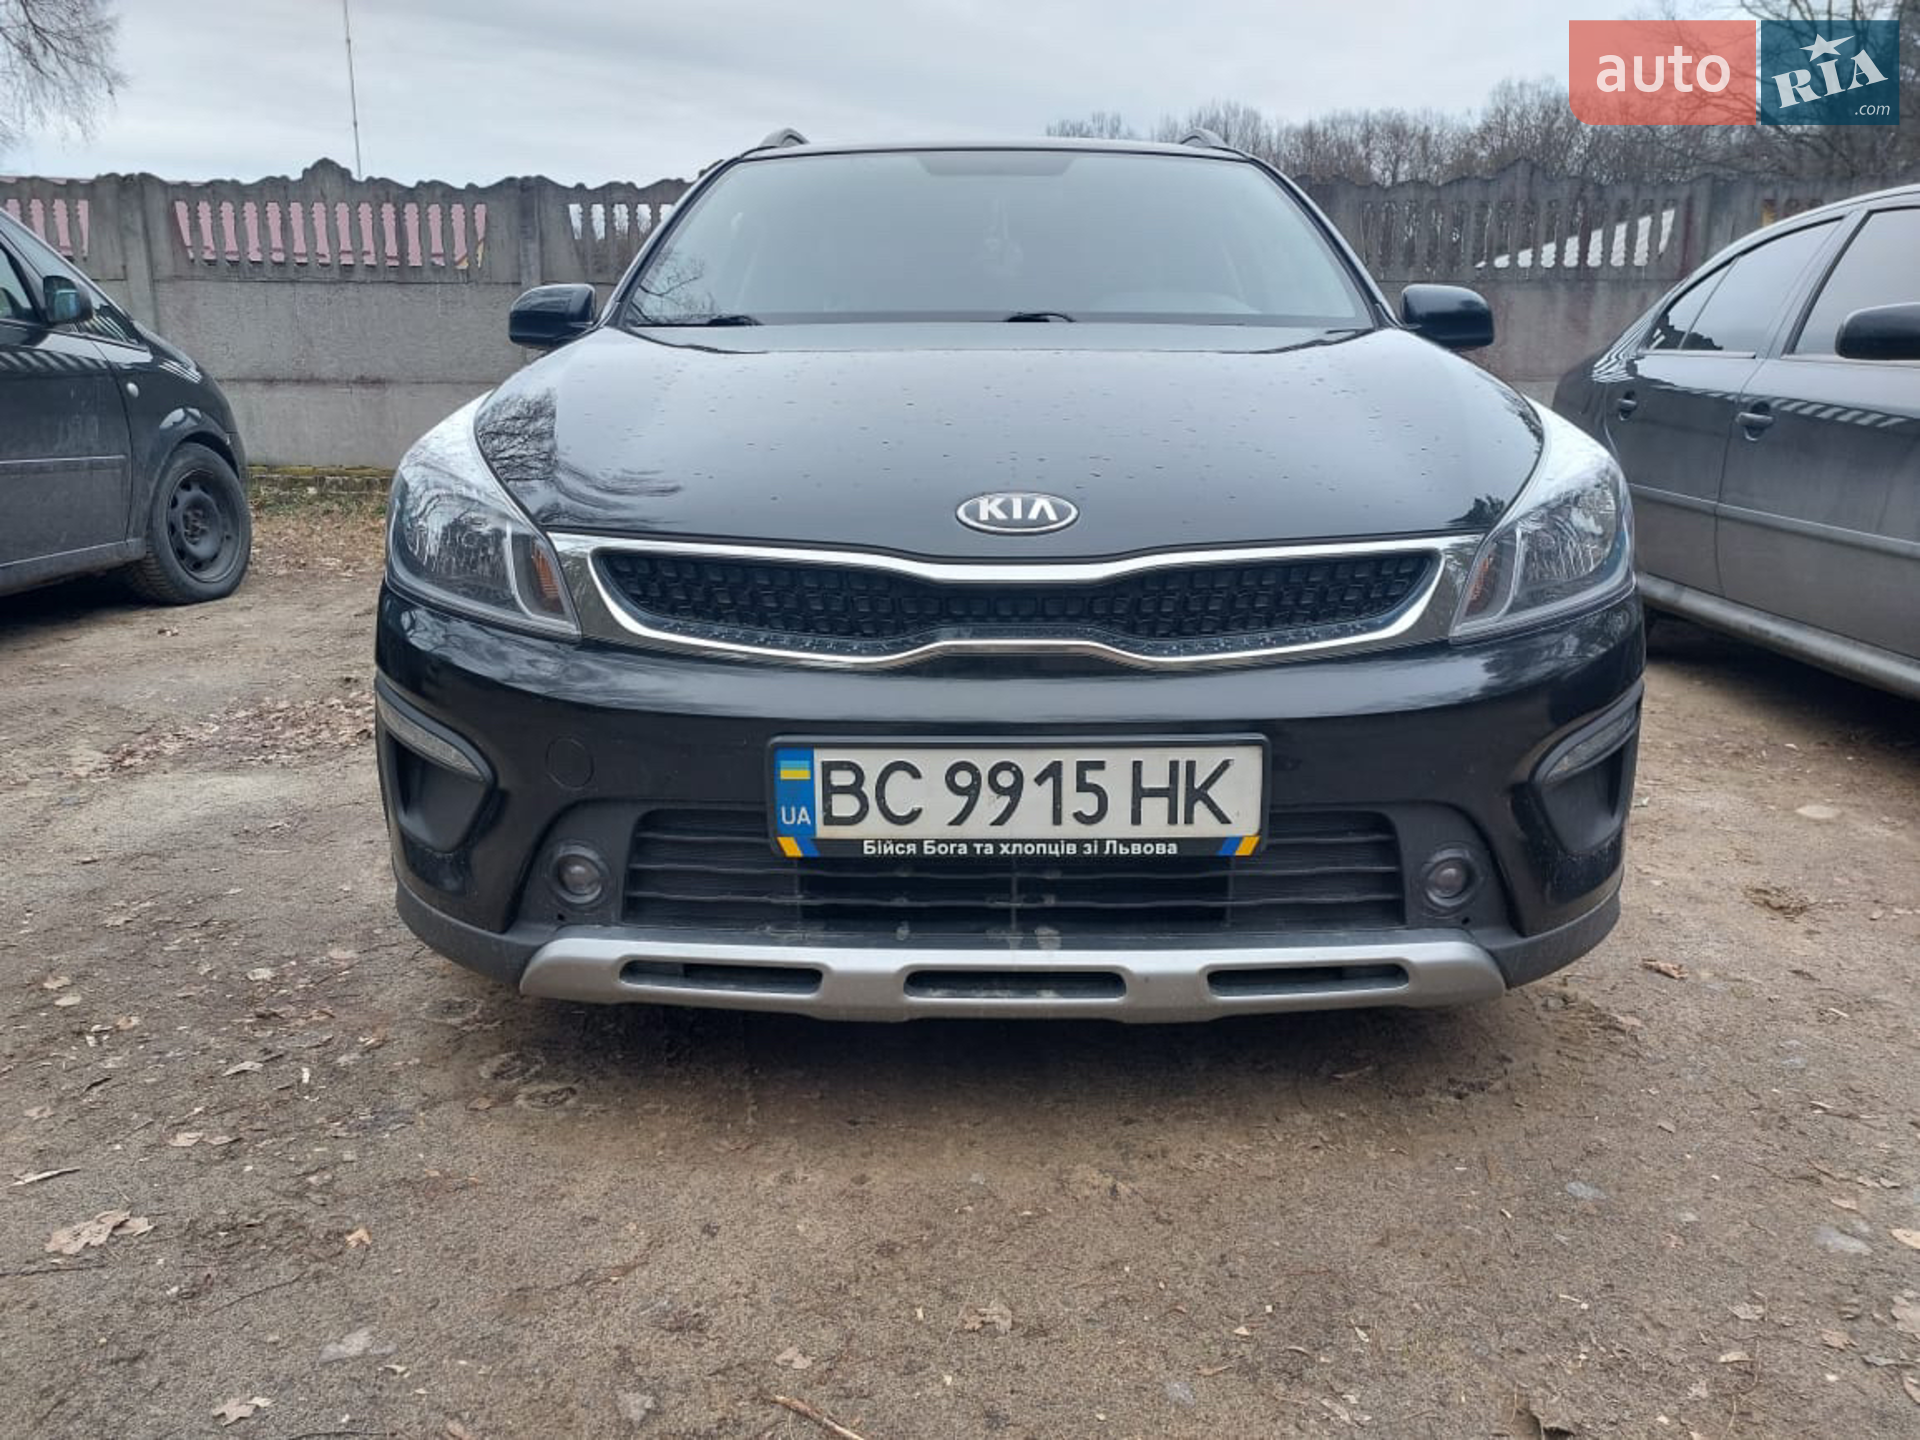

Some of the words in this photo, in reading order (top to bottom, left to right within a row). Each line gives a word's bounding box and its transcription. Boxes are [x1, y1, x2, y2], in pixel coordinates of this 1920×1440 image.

[979, 497, 1058, 521] KIA
[821, 760, 923, 826] BC
[945, 759, 1109, 826] 9915
[1130, 759, 1235, 826] HK
[781, 805, 811, 825] UA
[862, 839, 917, 855] Бійся
[922, 839, 968, 855] Бога
[973, 842, 994, 855] та
[999, 840, 1077, 857] хлопців
[1082, 840, 1099, 855] зі
[1104, 840, 1178, 855] Львова
